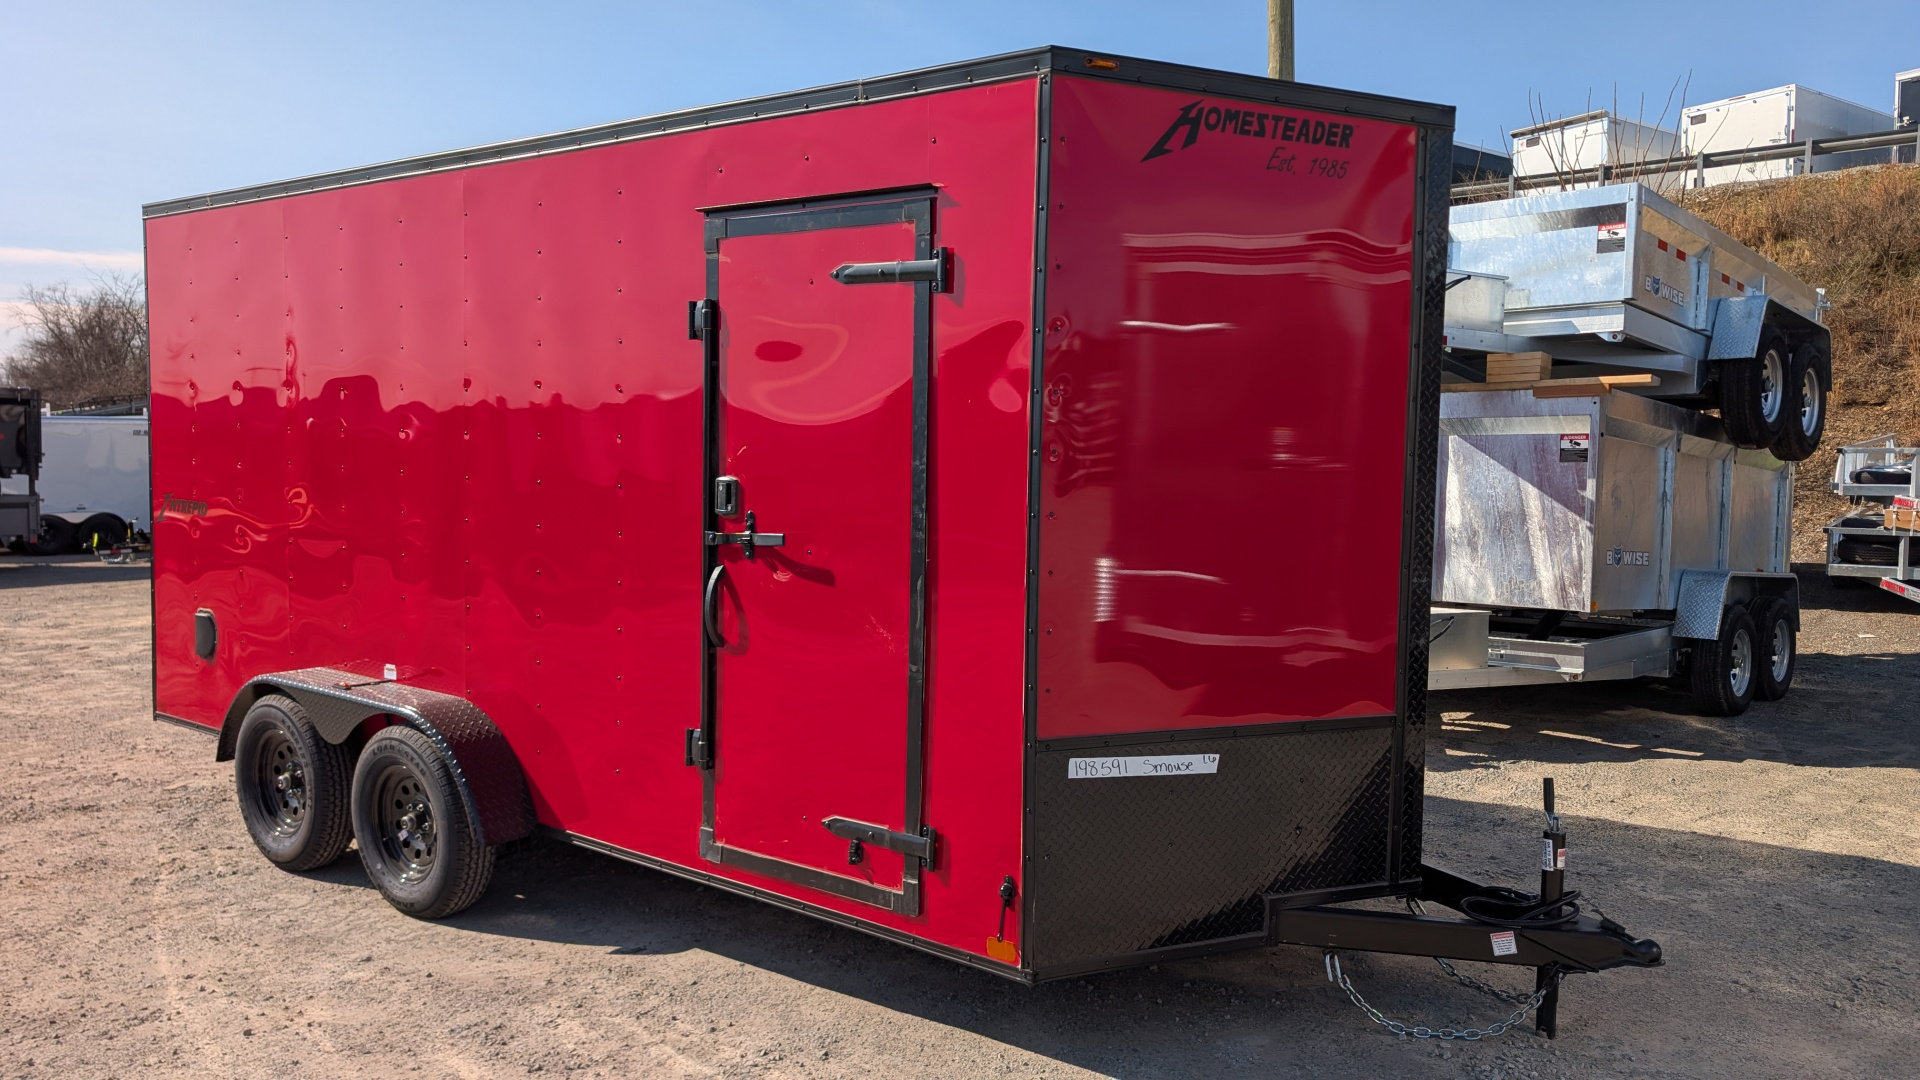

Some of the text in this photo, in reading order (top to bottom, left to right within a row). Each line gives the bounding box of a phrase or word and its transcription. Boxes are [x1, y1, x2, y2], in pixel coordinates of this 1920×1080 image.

[1140, 98, 1355, 163] HOMESTEADER
[1266, 146, 1350, 179] Est. 1985
[156, 493, 208, 521] INTREPID
[1074, 758, 1129, 777] 198591
[1143, 759, 1194, 774] Smouse
